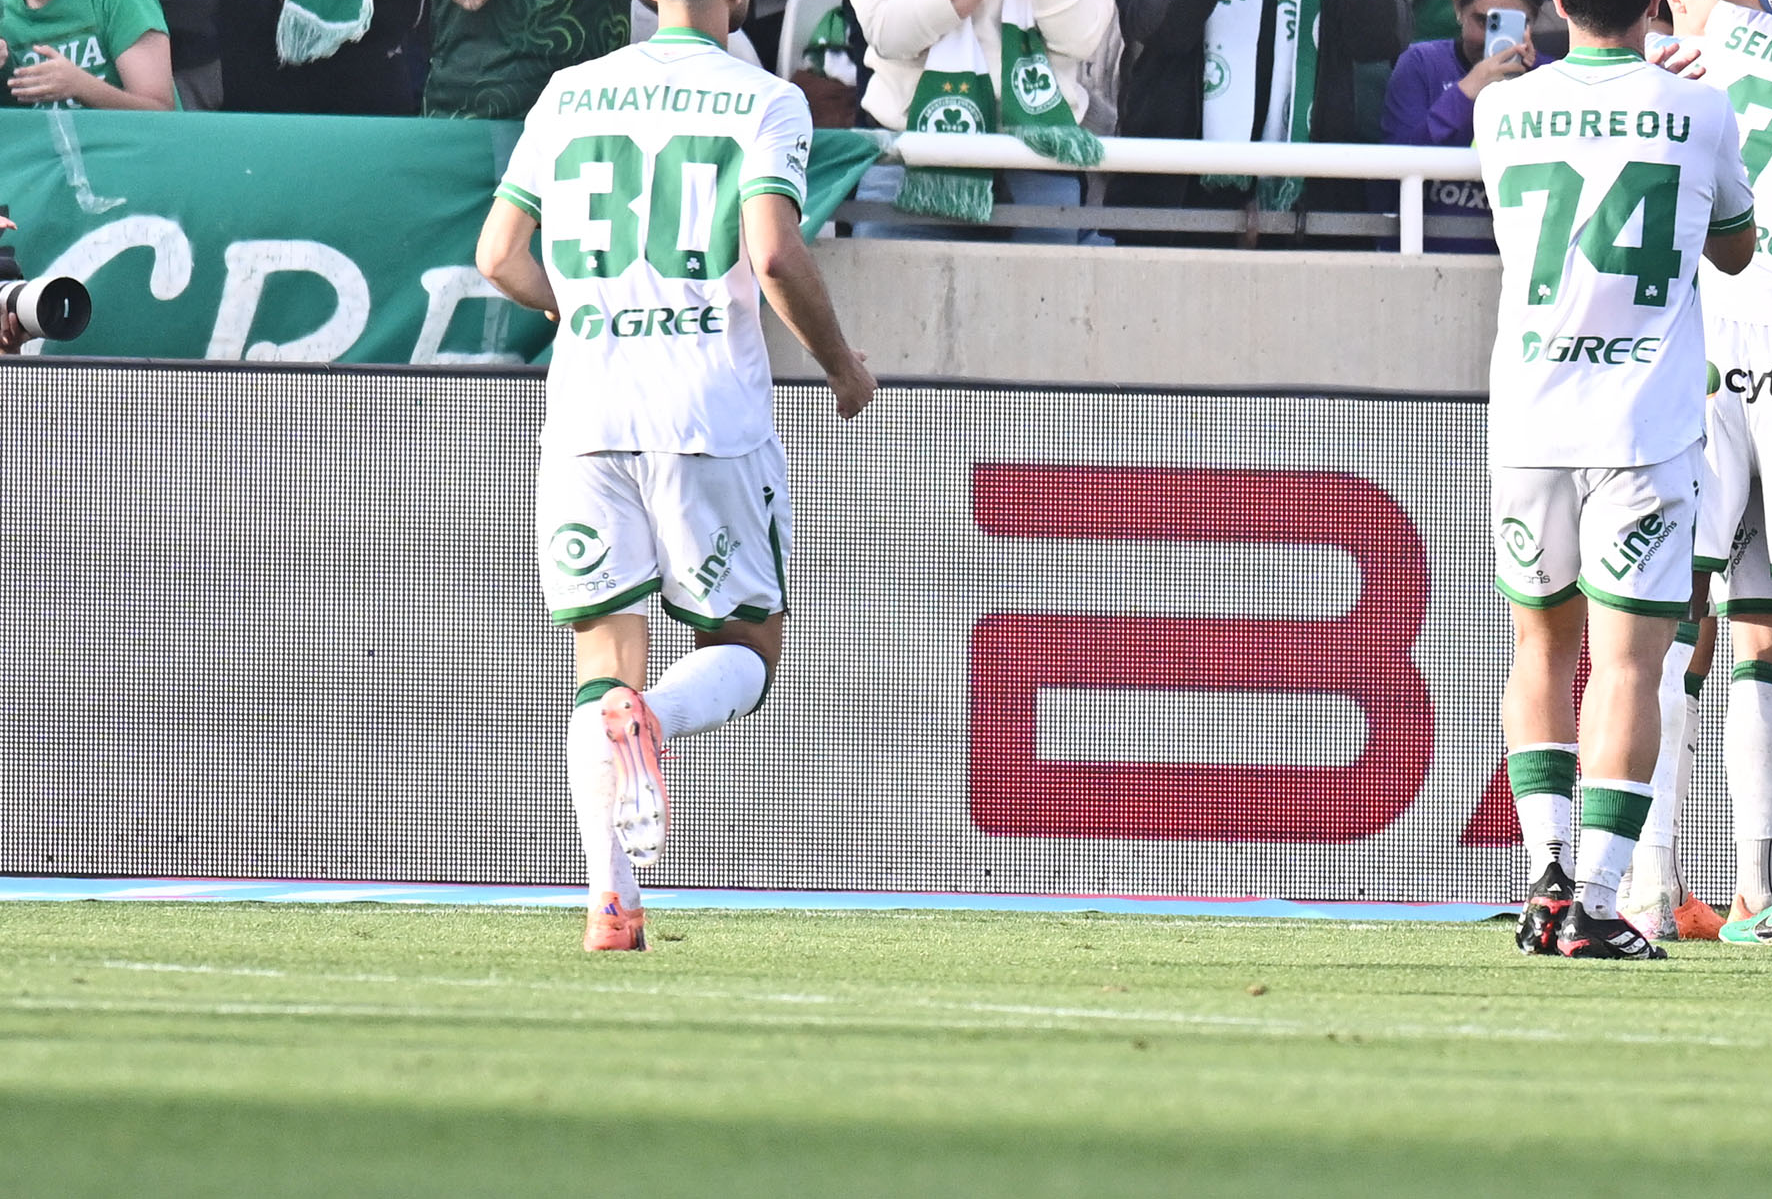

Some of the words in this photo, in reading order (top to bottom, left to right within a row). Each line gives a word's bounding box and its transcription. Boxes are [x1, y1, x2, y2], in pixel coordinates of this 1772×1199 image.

[557, 84, 757, 117] PANAYIOTOU
[1496, 109, 1691, 144] ANDREOU
[551, 134, 745, 281] 30
[1499, 161, 1682, 308] 74
[612, 305, 725, 339] GREE
[1545, 334, 1663, 366] GREE
[678, 530, 729, 604] Line
[1600, 512, 1664, 582] Line
[1636, 519, 1679, 574] promotions
